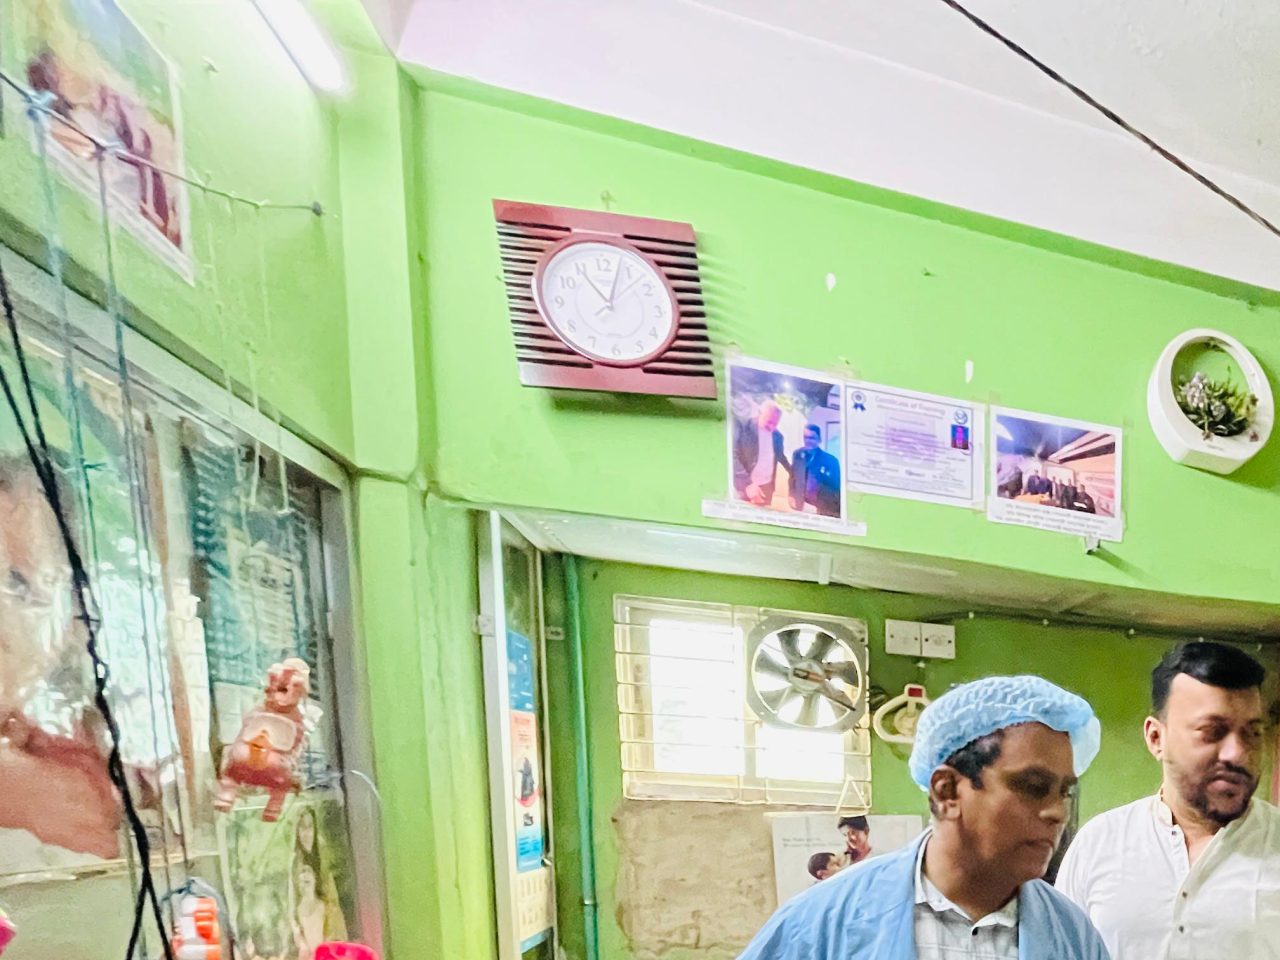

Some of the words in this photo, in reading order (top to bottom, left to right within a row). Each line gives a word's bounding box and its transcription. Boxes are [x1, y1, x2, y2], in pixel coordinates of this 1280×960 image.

[575, 262, 587, 277] 11
[595, 258, 611, 272] 12
[560, 275, 576, 290] 10
[644, 285, 654, 296] 2
[555, 297, 564, 308] 9
[655, 306, 663, 317] 3
[567, 321, 576, 333] 8
[649, 327, 658, 340] 4
[588, 336, 597, 349] 7
[635, 341, 646, 353] 5
[612, 344, 620, 356] 6
